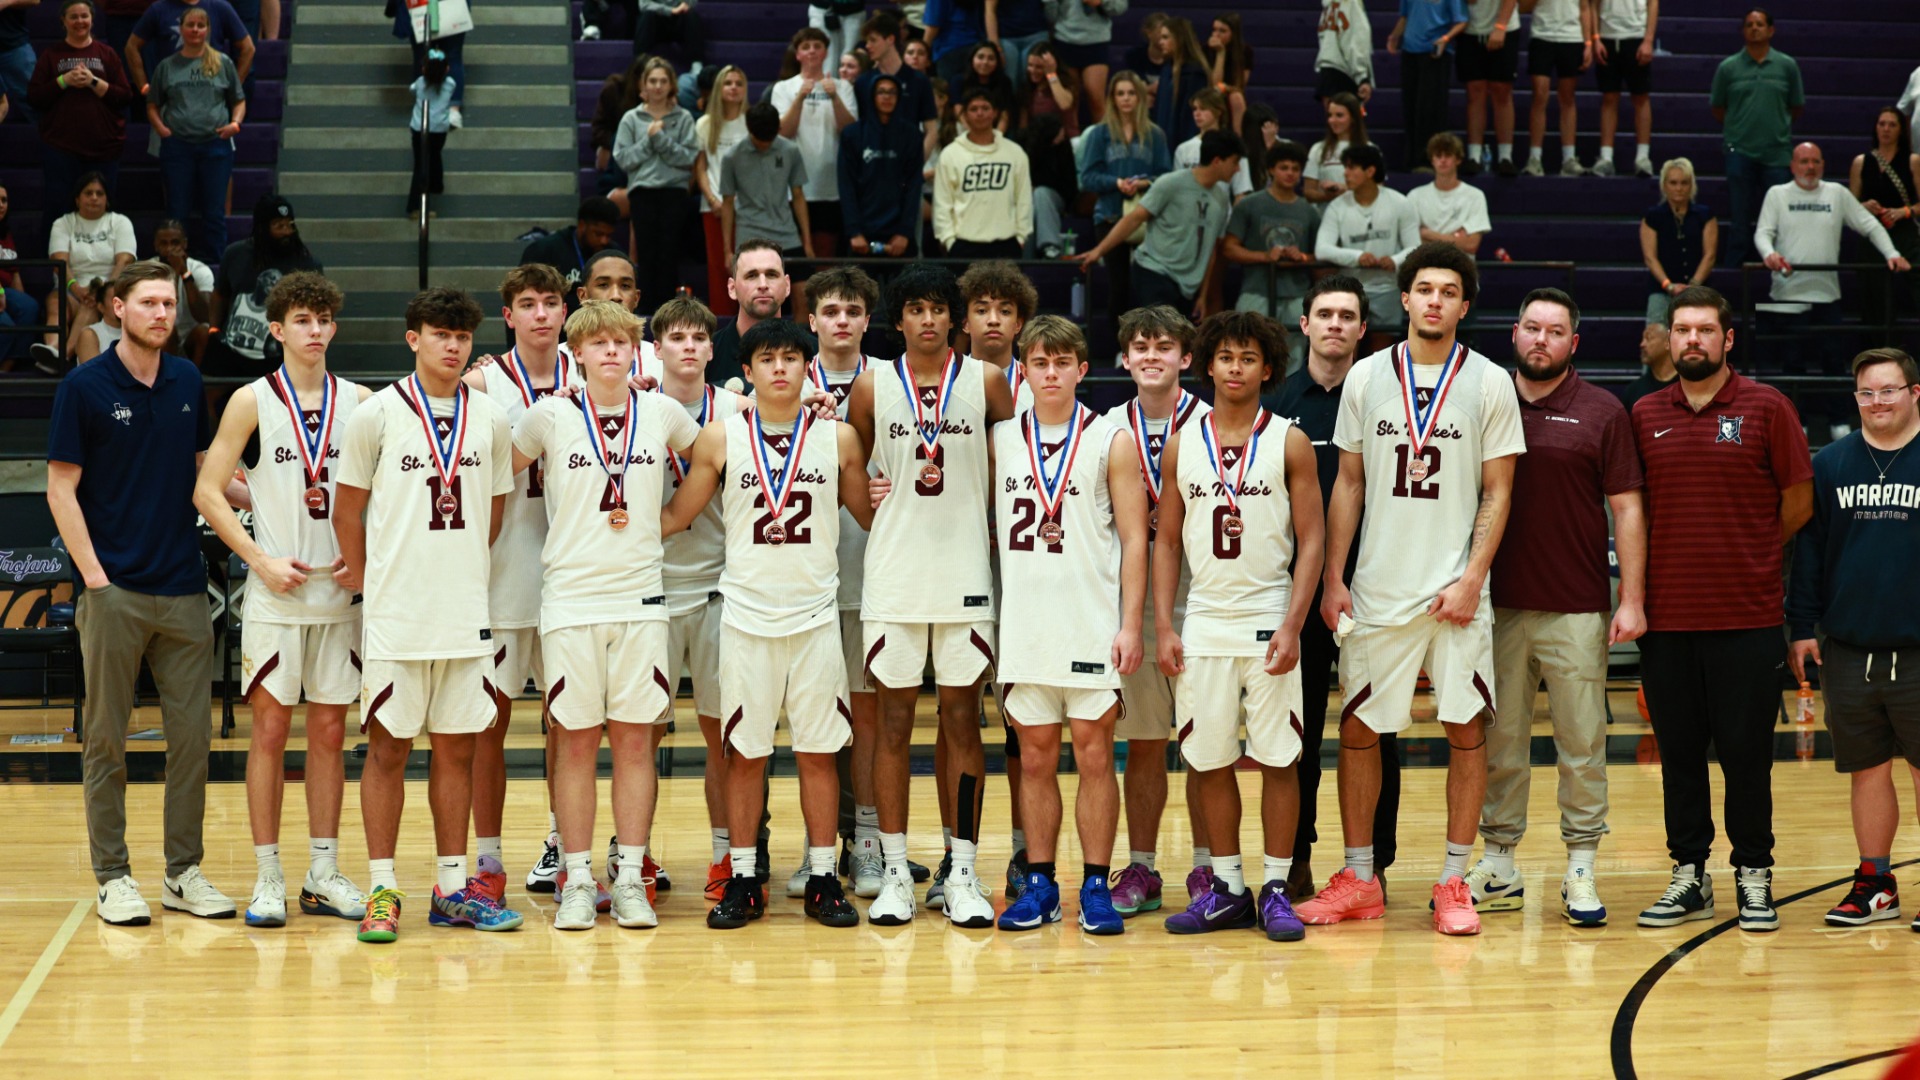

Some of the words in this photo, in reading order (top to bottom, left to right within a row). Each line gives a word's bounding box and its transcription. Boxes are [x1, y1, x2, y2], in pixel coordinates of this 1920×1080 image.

[962, 162, 1012, 192] SEU
[890, 422, 910, 440] St.
[913, 418, 973, 436] Mke's
[1376, 419, 1400, 437] St.
[1403, 422, 1463, 440] ke's
[274, 446, 298, 464] St.
[400, 454, 425, 472] St.
[568, 453, 592, 469] St.
[600, 449, 656, 468] Mke's
[740, 472, 760, 490] St
[769, 467, 827, 485] Mke's
[914, 441, 945, 497] 3
[1392, 443, 1442, 501] 12
[426, 474, 466, 531] 11
[599, 472, 628, 512] 4
[1189, 482, 1208, 500] St.
[1211, 479, 1273, 497] Mke's
[752, 490, 813, 545] 22
[1008, 497, 1066, 555] 24
